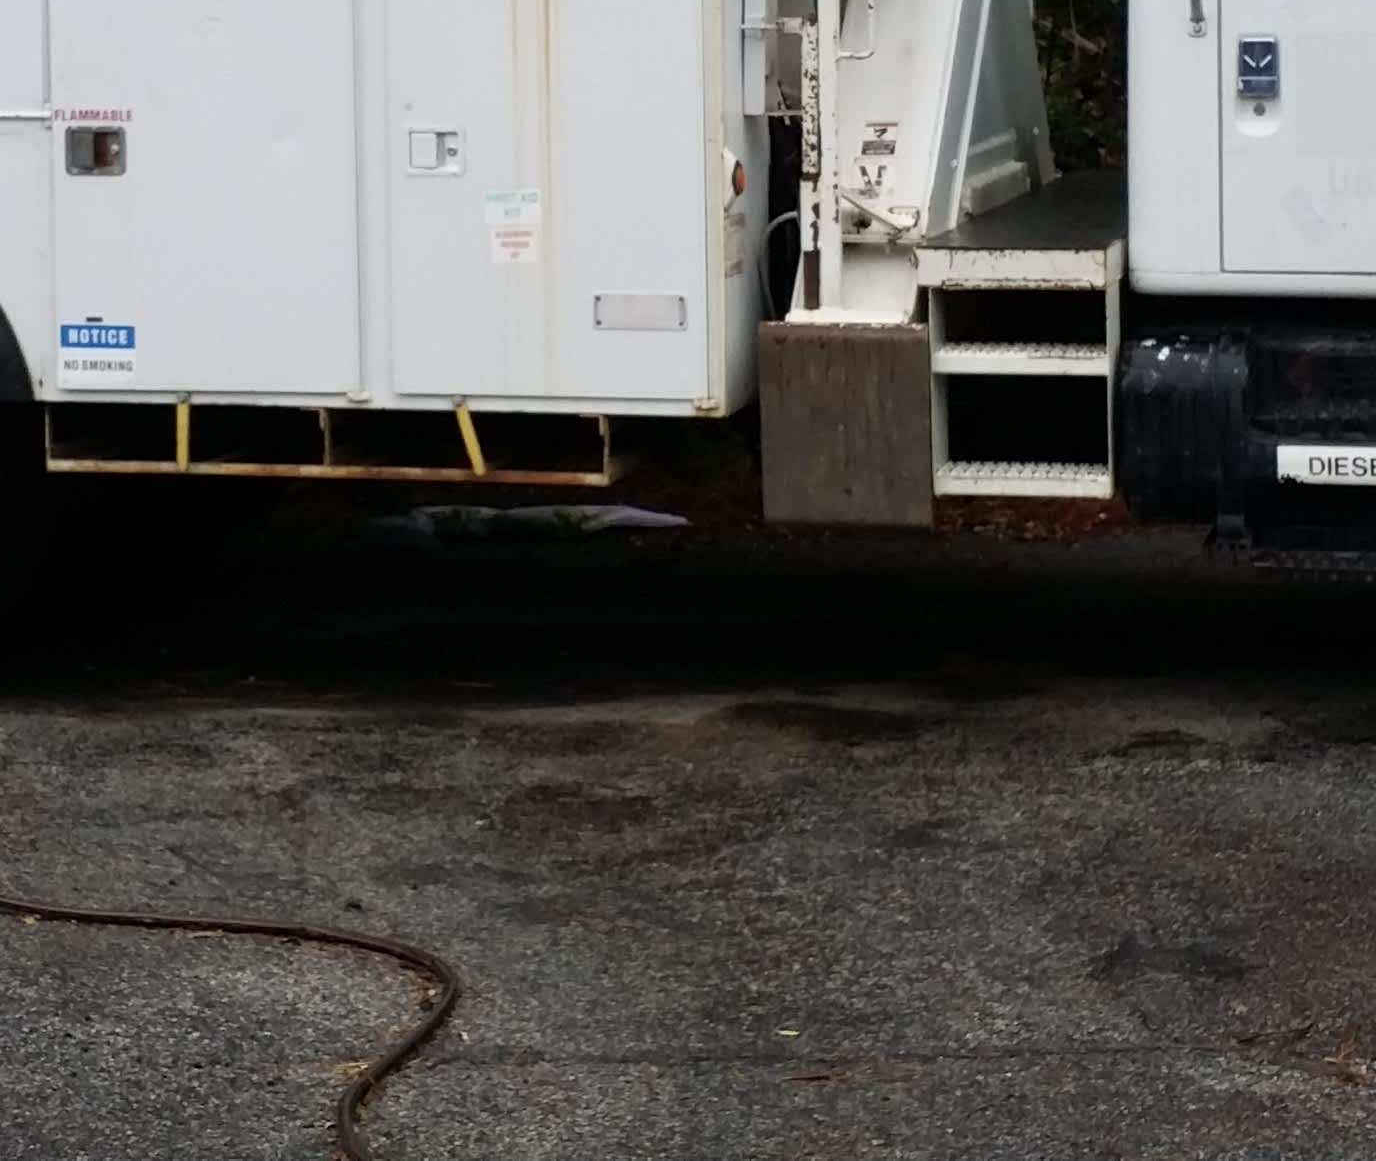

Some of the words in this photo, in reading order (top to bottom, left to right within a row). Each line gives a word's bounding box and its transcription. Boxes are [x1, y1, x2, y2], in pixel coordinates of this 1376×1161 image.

[54, 109, 132, 122] FLAMMABLE
[68, 328, 128, 345] NOTICE
[64, 359, 79, 371] NO
[82, 359, 133, 373] SMOKING
